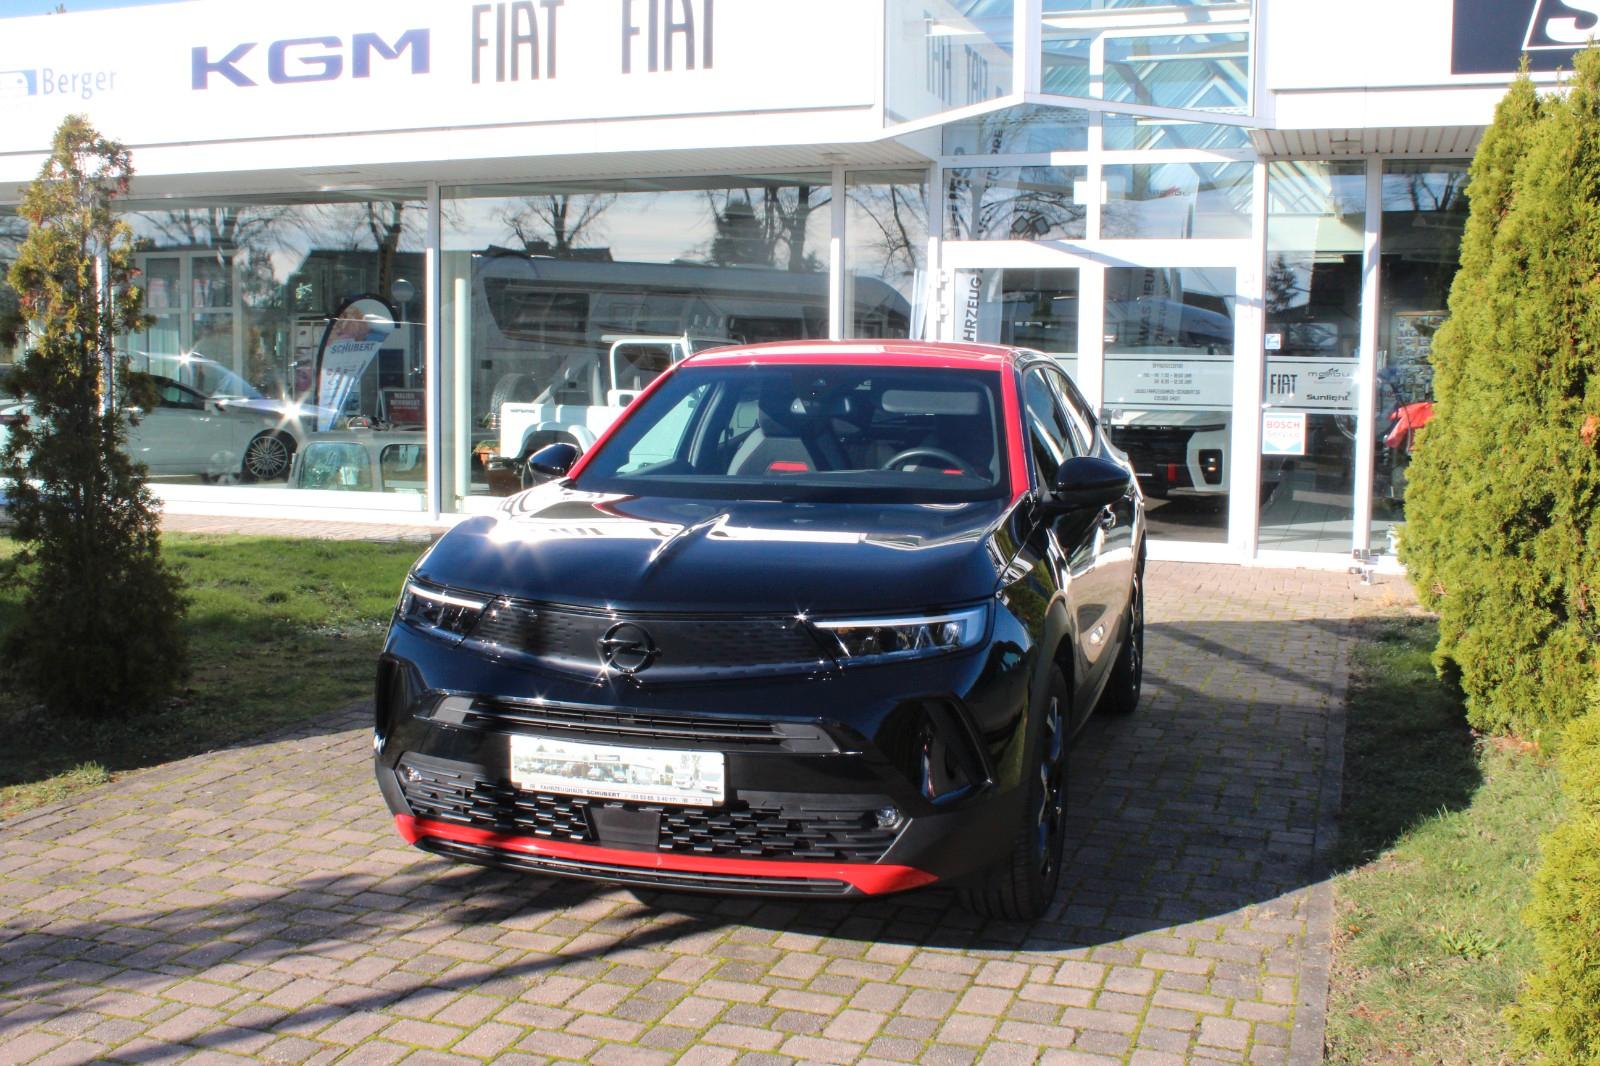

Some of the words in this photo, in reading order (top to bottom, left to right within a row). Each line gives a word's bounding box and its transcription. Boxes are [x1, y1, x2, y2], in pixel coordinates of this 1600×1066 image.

[471, 0, 564, 84] FIAT
[191, 28, 430, 91] KGM
[42, 67, 117, 100] Berger
[330, 342, 375, 354] SCHUBERT
[1270, 373, 1298, 395] FIAT
[1306, 393, 1350, 403] Sunlight
[1266, 420, 1300, 430] BOSCH
[586, 789, 621, 798] SCHUBERT
